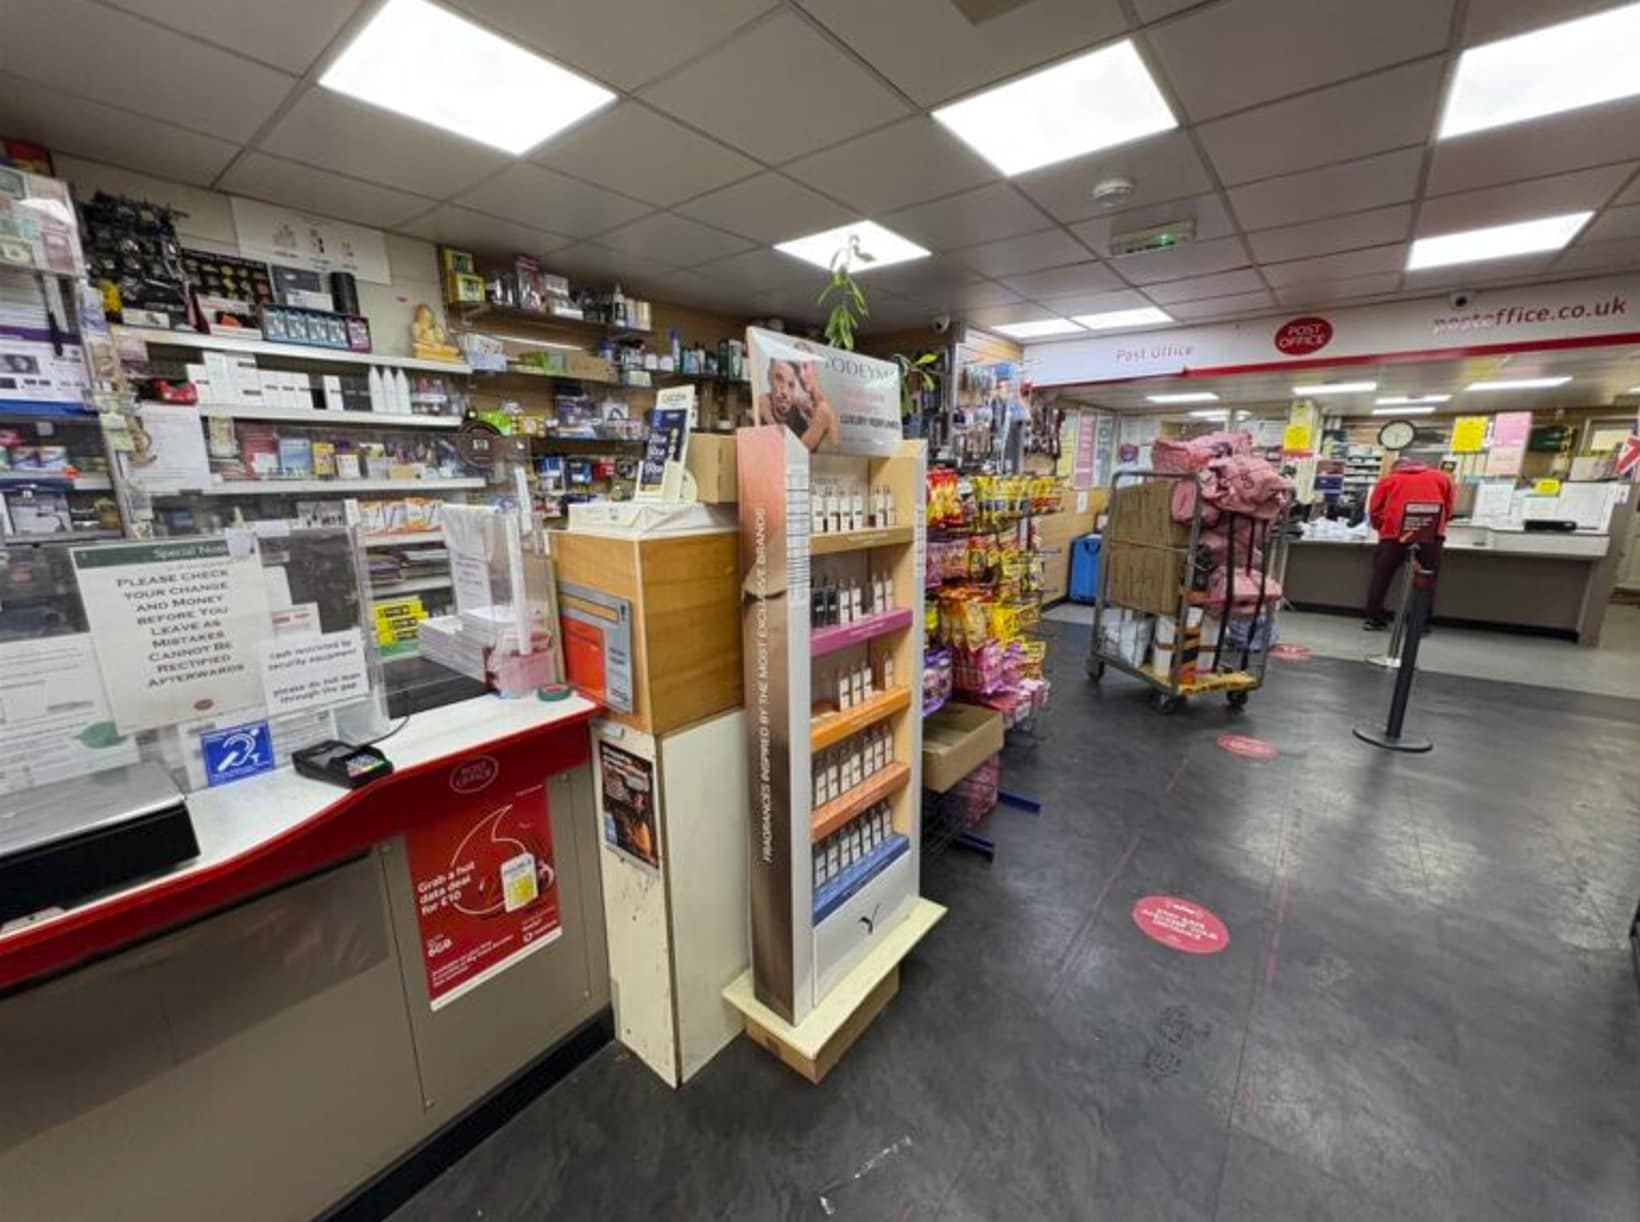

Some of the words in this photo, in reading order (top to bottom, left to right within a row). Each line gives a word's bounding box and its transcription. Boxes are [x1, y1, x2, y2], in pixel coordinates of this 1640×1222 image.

[1287, 322, 1323, 335] POST
[1278, 334, 1326, 350] OFFICE
[1115, 348, 1146, 362] Post
[1150, 343, 1195, 359] Office
[754, 507, 767, 566] BRANDS
[116, 573, 179, 588] PLEASE
[180, 568, 229, 583] CHECK
[123, 588, 166, 601] YOUR
[168, 581, 229, 596] CHANGE
[135, 600, 169, 612] AND
[171, 594, 224, 607] MONEY
[756, 567, 768, 639] EXCLUSIVE
[136, 610, 197, 625] BEFORE
[201, 606, 229, 616] YOU
[151, 623, 199, 636] LEAVE
[203, 619, 222, 628] AS
[151, 631, 226, 649] MISTAKES
[147, 644, 210, 662] CANNOT
[213, 641, 233, 651] BE
[757, 642, 768, 678] MOST
[156, 654, 232, 673] RECTIFIED
[146, 663, 246, 688] AFTERWARDS
[758, 680, 769, 704] THE
[759, 707, 770, 725] BY
[760, 727, 771, 782] INSPIRED
[762, 783, 773, 863] FRAGRANCES
[417, 875, 447, 893] Grab
[448, 871, 455, 880] a
[456, 860, 476, 874] hot
[419, 888, 447, 904] data
[447, 874, 472, 891] deal
[421, 903, 439, 916] for
